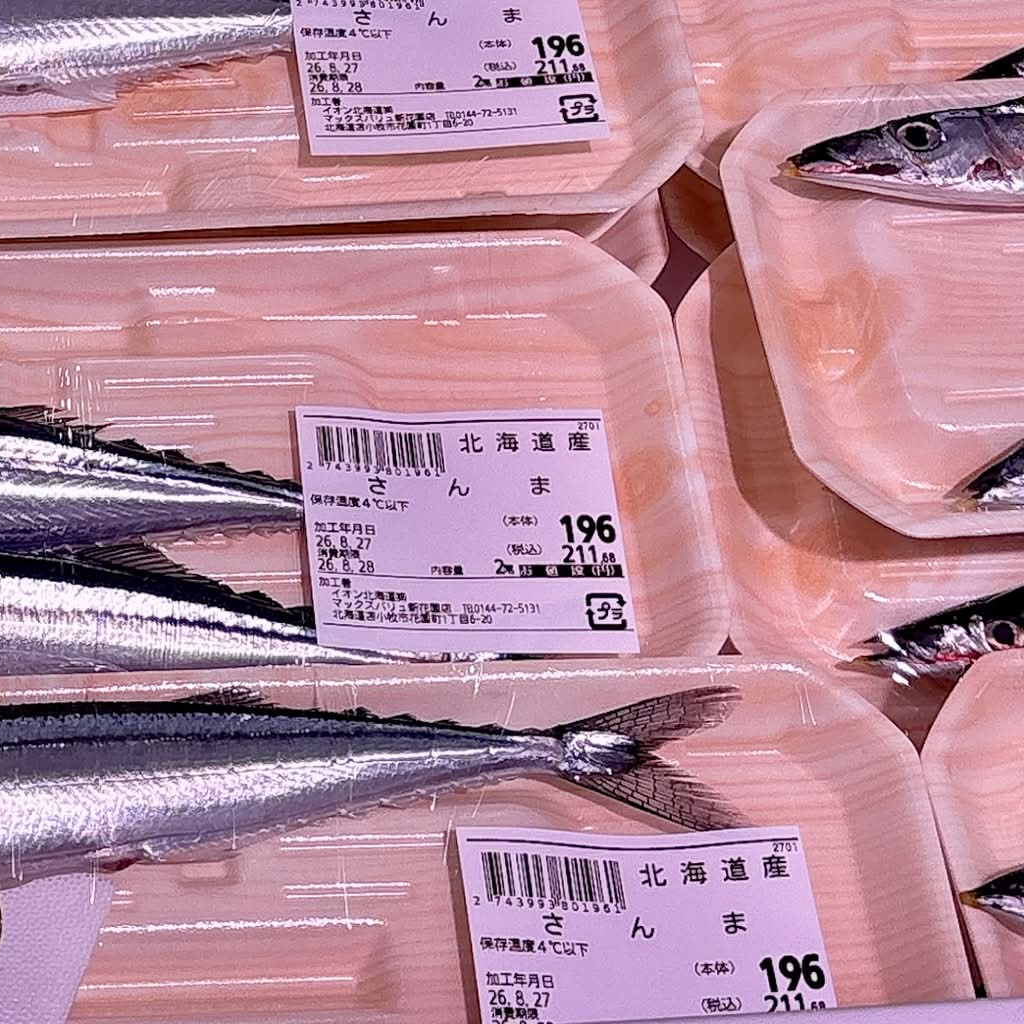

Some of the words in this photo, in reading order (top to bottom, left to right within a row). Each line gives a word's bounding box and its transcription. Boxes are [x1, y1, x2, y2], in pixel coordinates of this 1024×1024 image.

[532, 34, 585, 59] 196
[577, 422, 600, 431] 2701
[459, 431, 592, 454] 北海道産
[560, 514, 616, 543] 196
[598, 602, 623, 620] プラ
[772, 842, 798, 853] 2701
[640, 855, 790, 888] 北海道産
[486, 971, 554, 989] 加工年月日
[759, 953, 826, 993] 196
